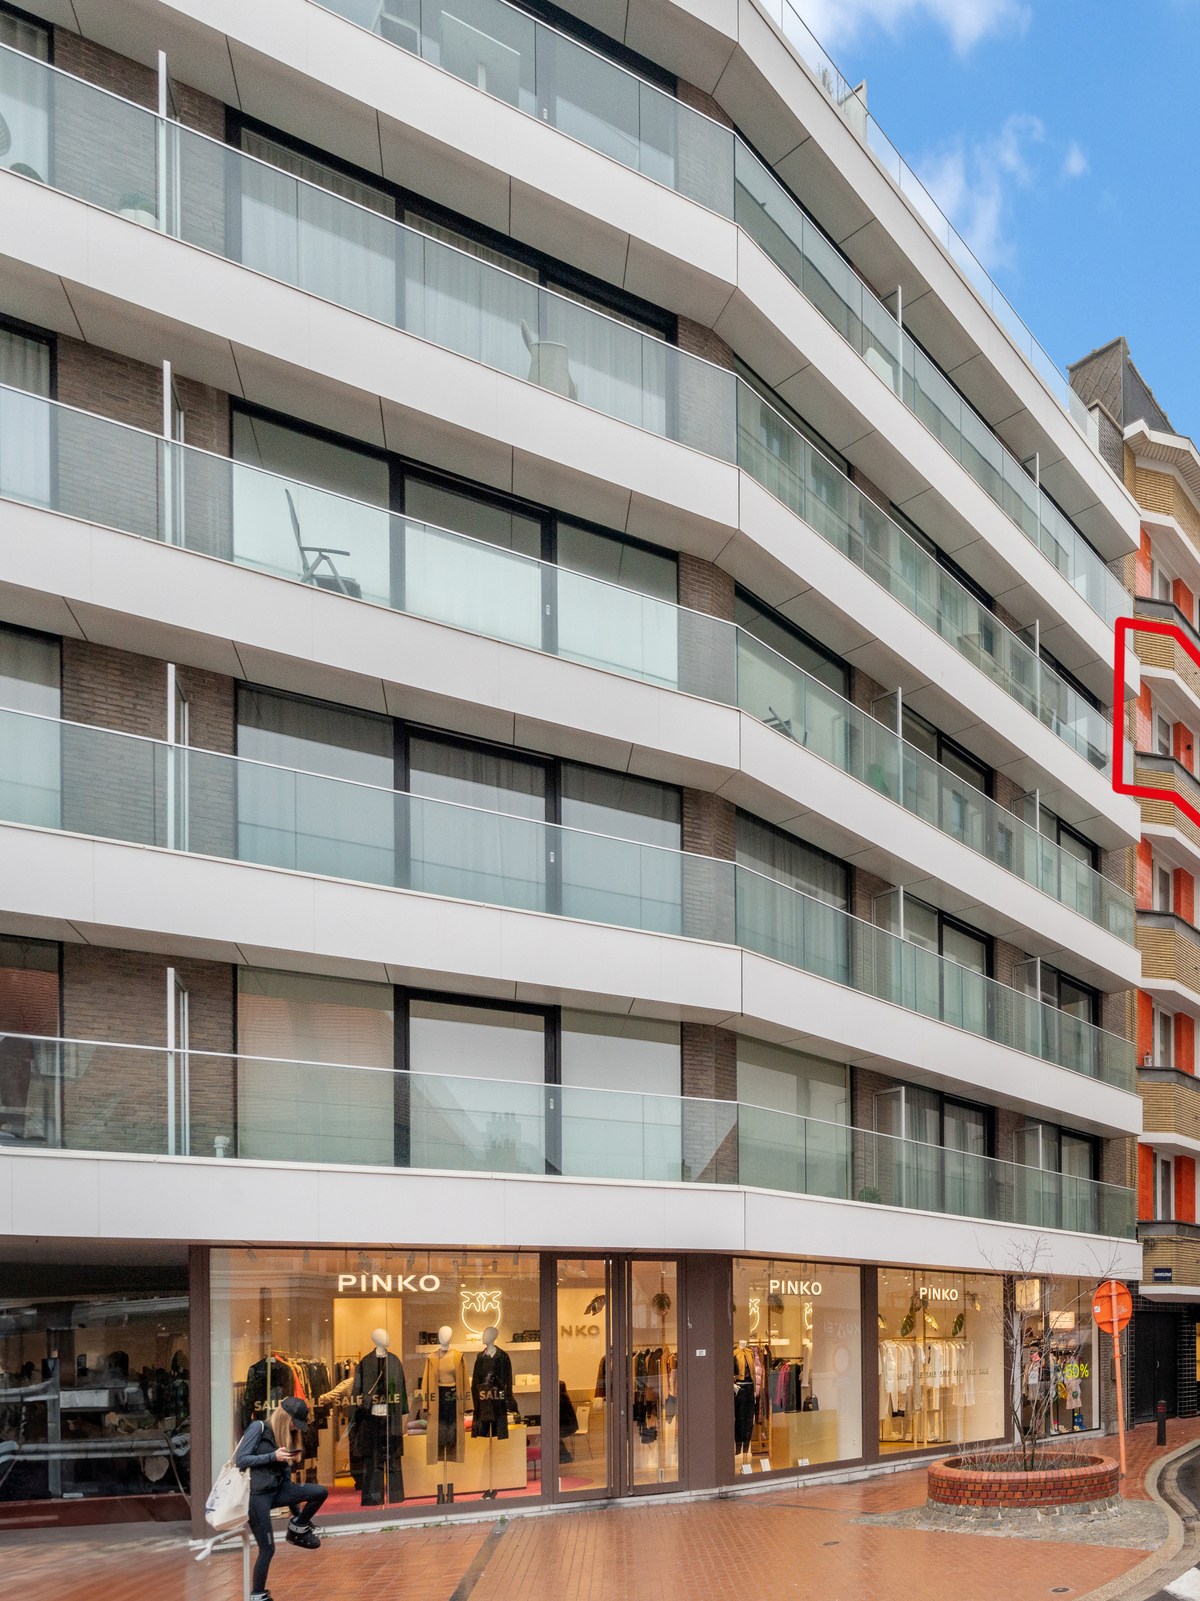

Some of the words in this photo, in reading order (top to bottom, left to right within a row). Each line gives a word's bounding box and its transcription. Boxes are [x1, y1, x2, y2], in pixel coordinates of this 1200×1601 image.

[338, 1275, 440, 1291] PINKO
[769, 1279, 822, 1296] PINKO
[919, 1287, 959, 1301] PINKO
[560, 1325, 600, 1337] NKO
[334, 1396, 362, 1406] SALE
[372, 1393, 400, 1404] SALE
[480, 1390, 506, 1401] SALE
